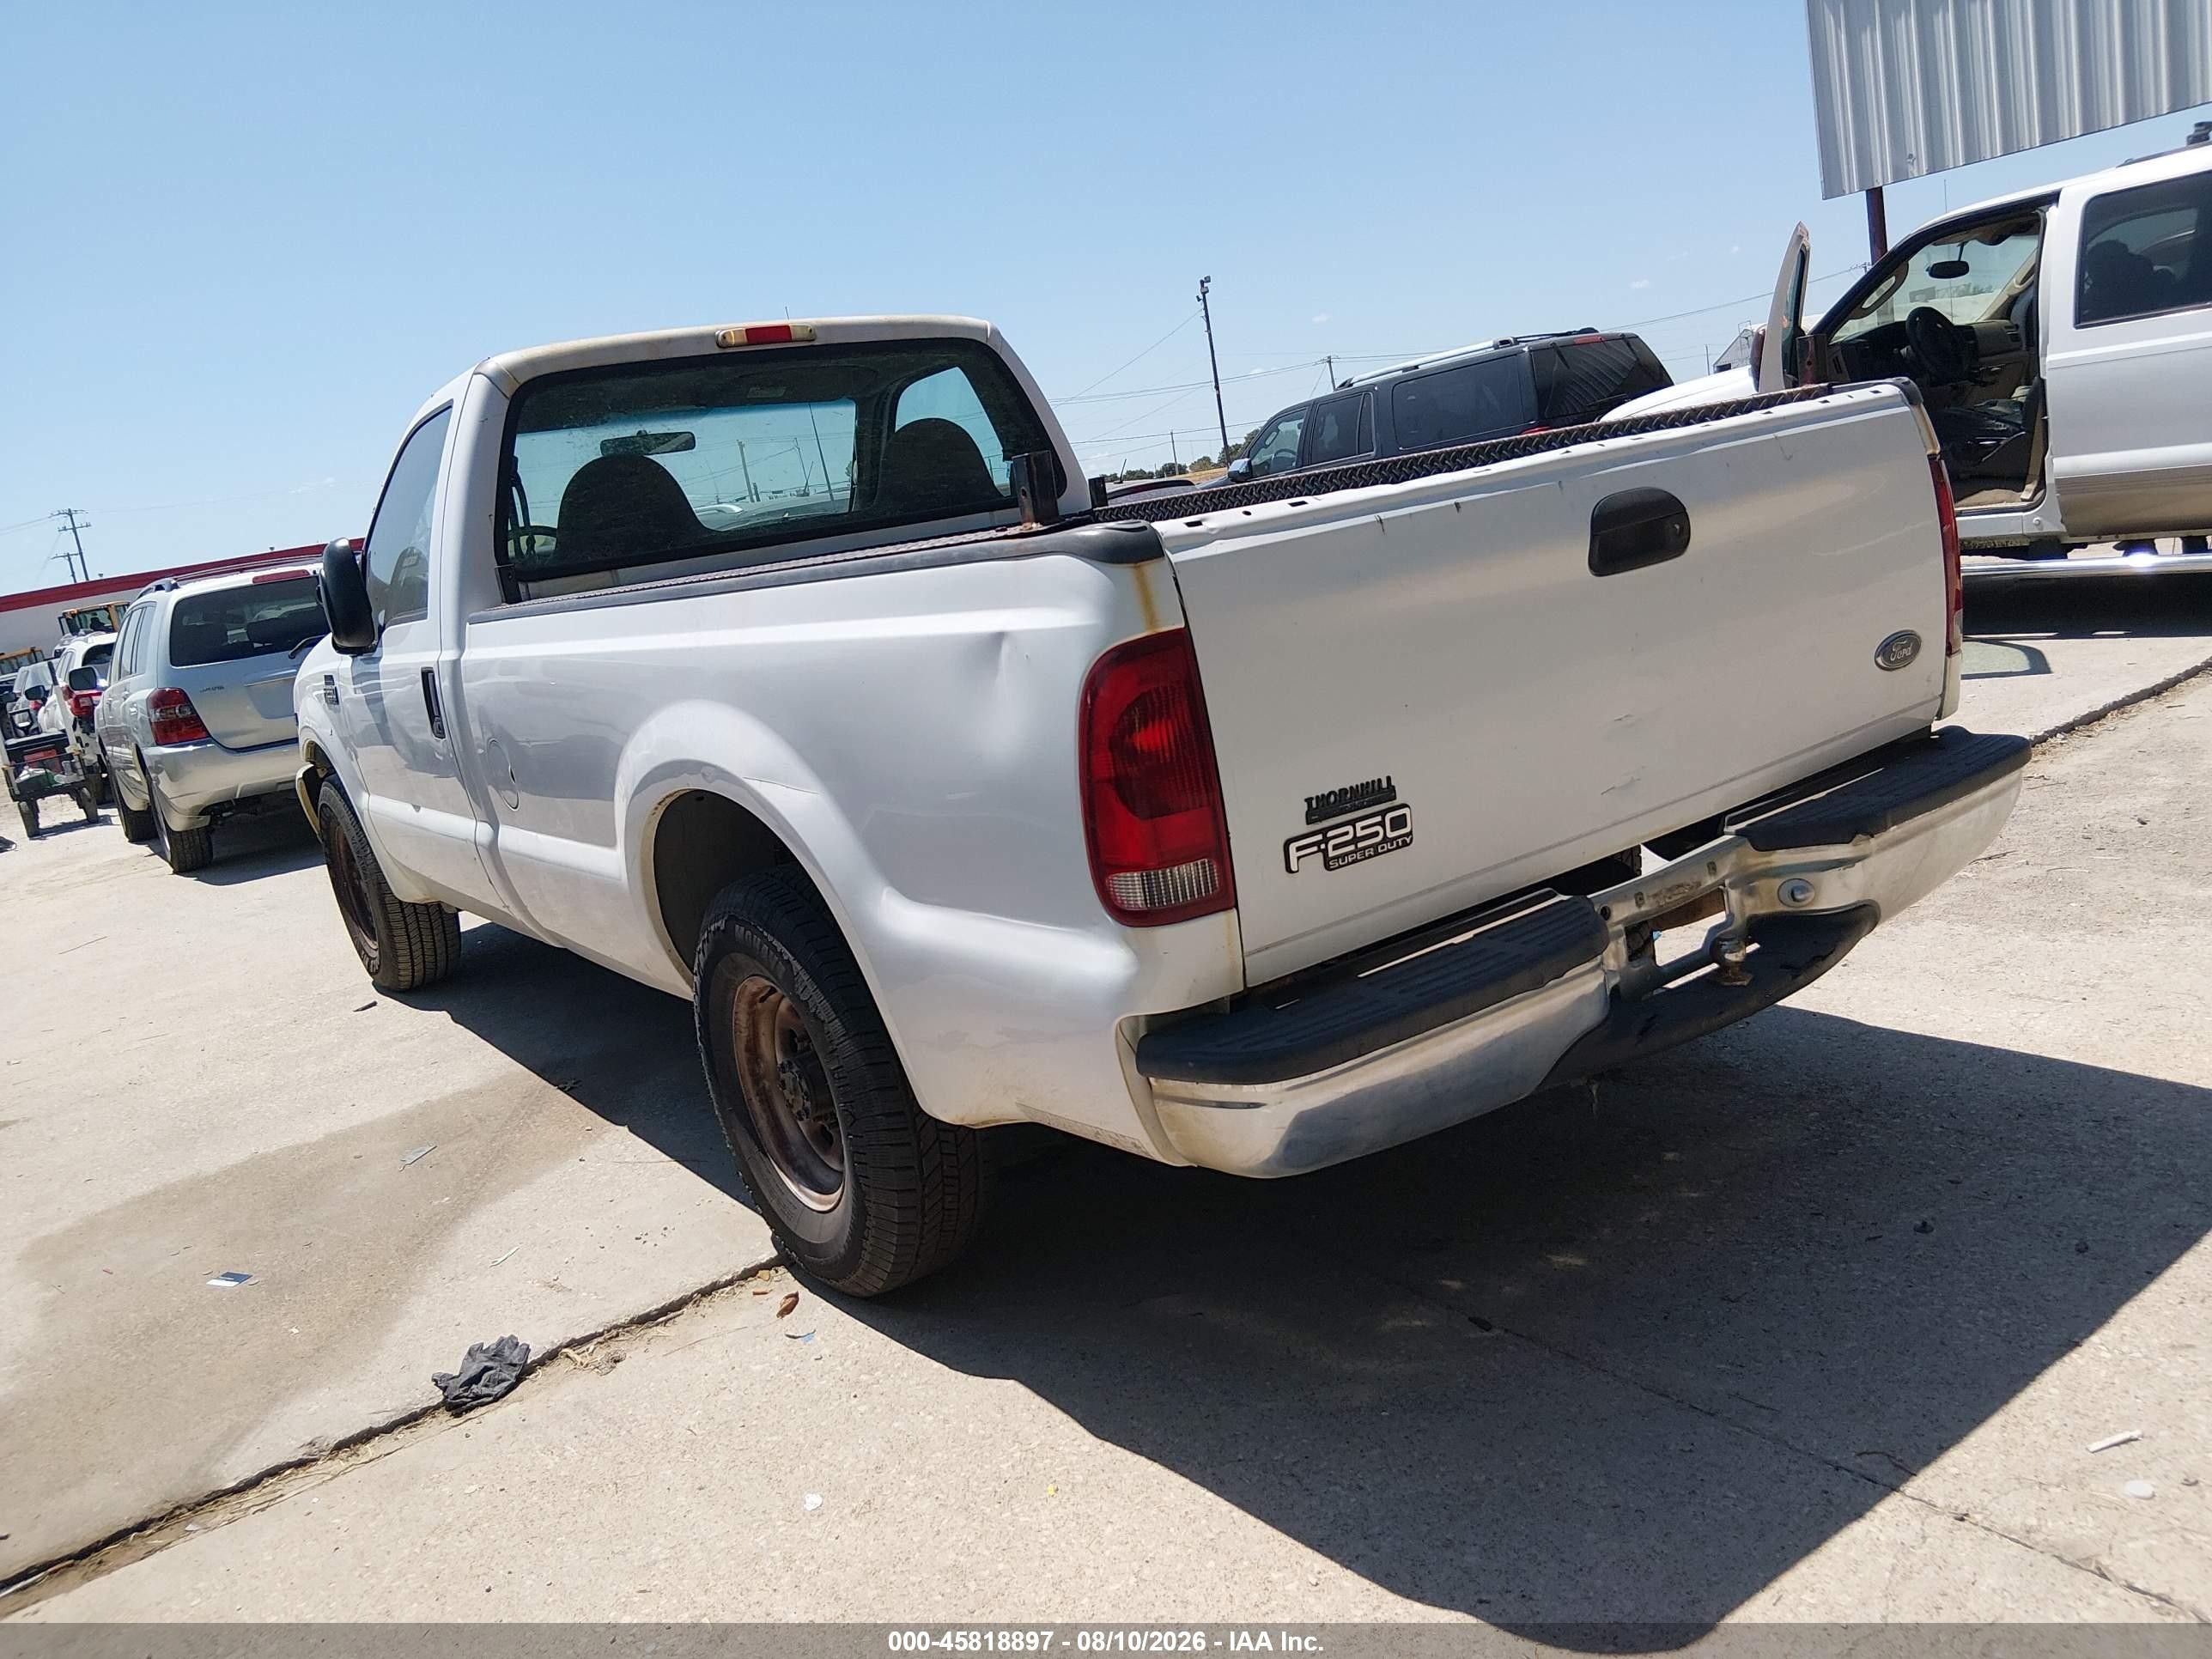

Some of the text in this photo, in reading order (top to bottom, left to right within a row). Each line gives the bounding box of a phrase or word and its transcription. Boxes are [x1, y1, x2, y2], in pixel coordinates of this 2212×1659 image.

[1889, 639, 1913, 661] Ford
[1304, 775, 1396, 812] THORNHILL
[1328, 835, 1413, 869] SUPER DUTY
